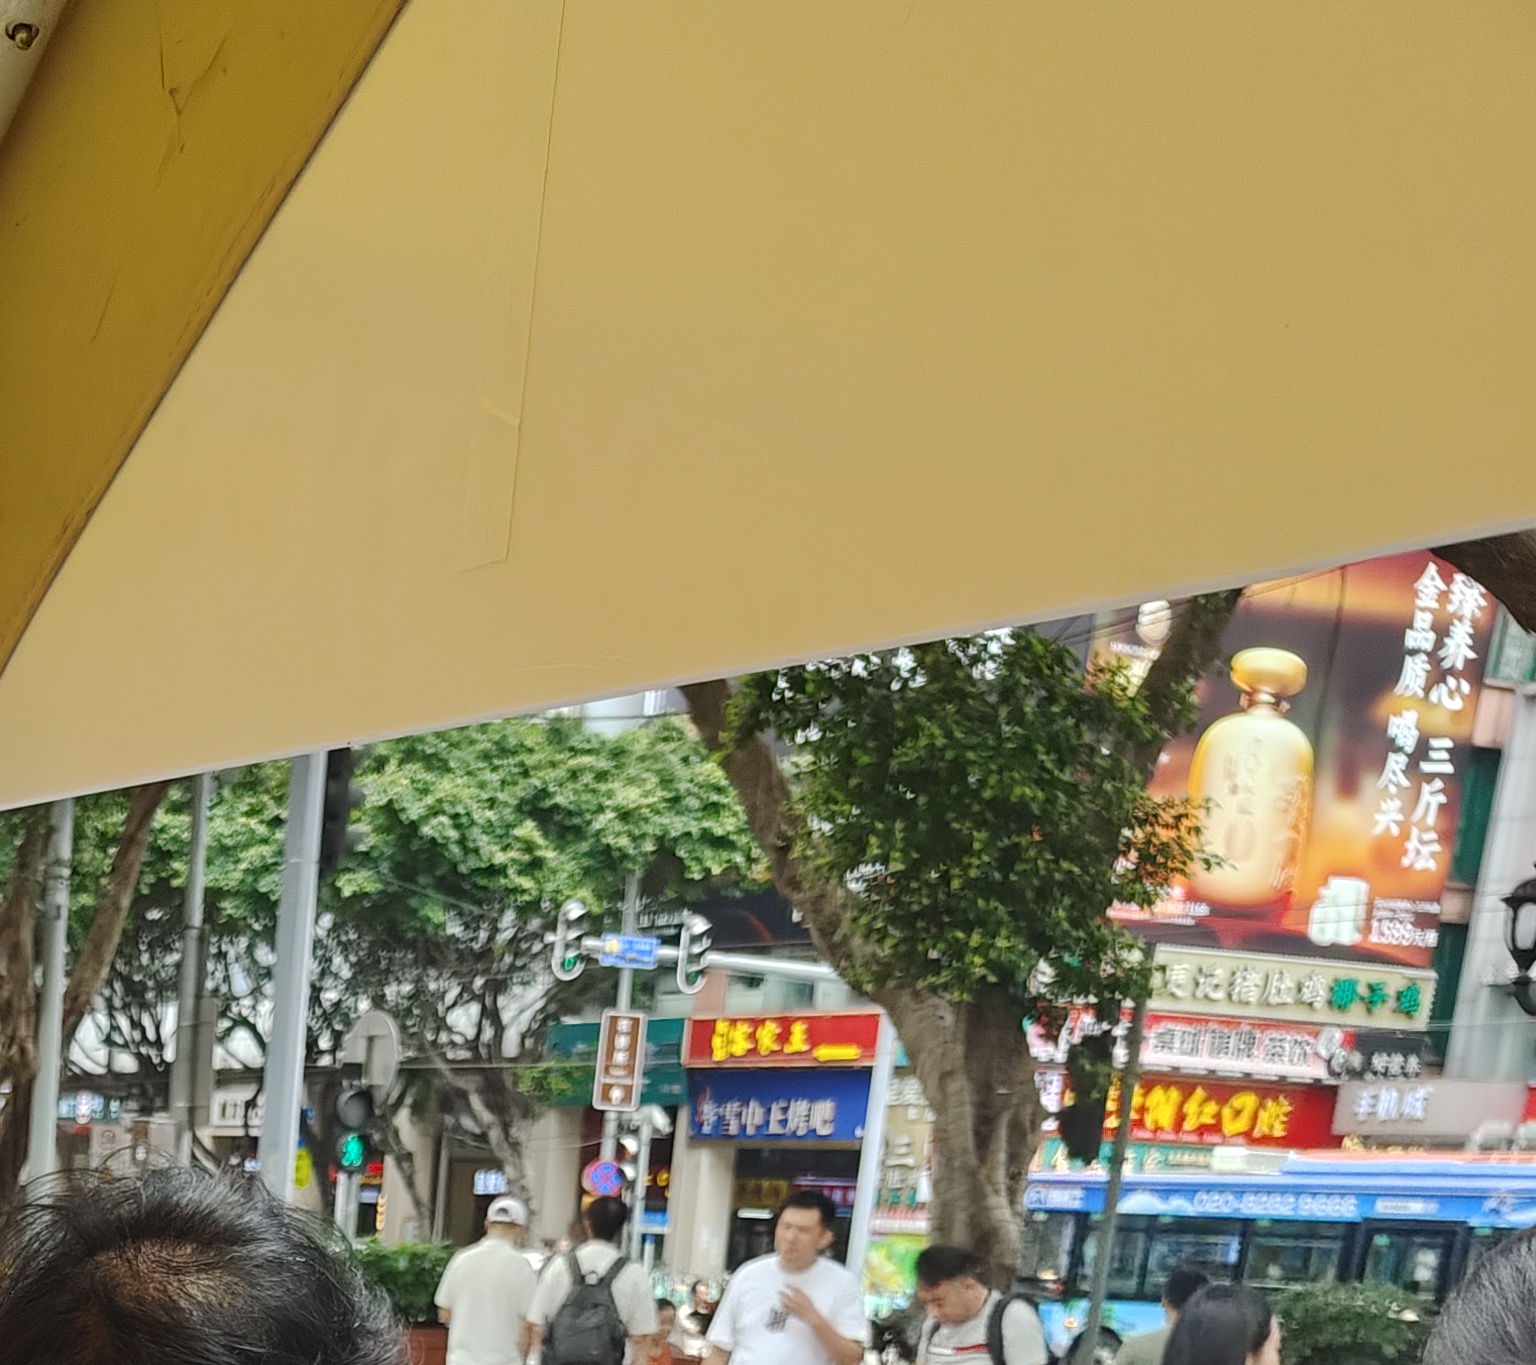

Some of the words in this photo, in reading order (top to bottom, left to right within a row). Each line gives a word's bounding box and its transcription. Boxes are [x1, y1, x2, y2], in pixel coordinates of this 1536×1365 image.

[1393, 561, 1448, 699] 金品质
[1400, 737, 1455, 871] 三斤坛
